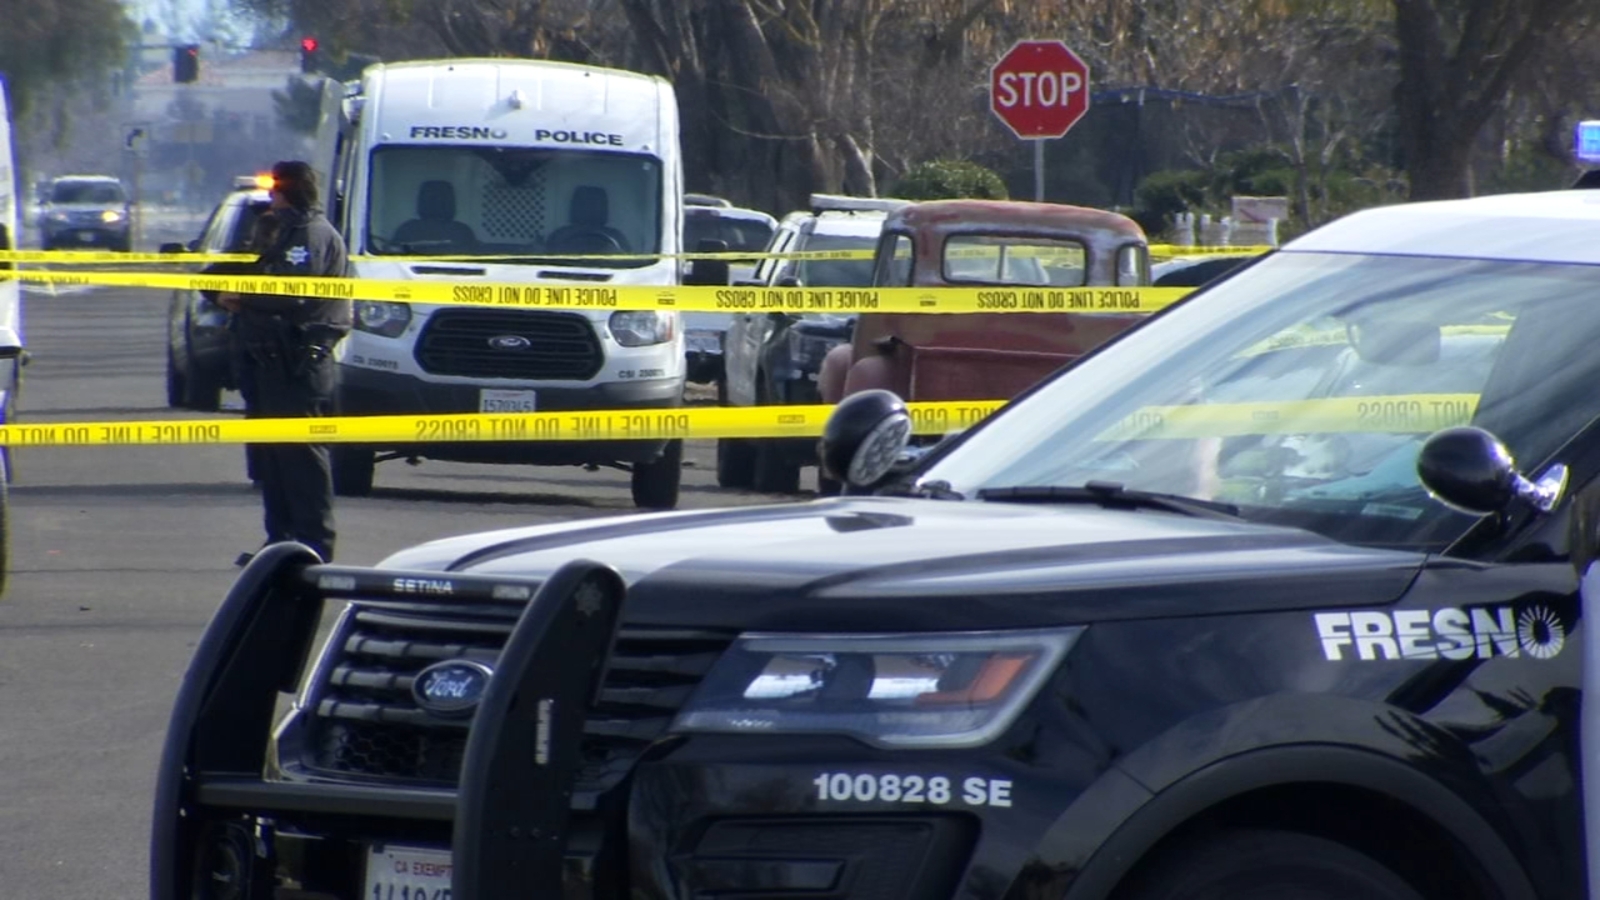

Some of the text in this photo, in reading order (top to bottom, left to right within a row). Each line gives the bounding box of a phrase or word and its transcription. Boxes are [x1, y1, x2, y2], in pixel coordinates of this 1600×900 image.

[999, 72, 1082, 108] STOP
[409, 126, 623, 146] FRESNO POLICE
[190, 279, 354, 298] POLICE LINE DO NOT CROSS
[453, 285, 617, 306] POLICE LINE DO NOT CROSS
[716, 291, 879, 308] POLICE LINE DO NOT CROSS
[977, 291, 1140, 309] POLICE LINE DO NOT CROSS
[393, 578, 454, 595] SETINA
[1314, 605, 1565, 661] FRESNO
[424, 672, 474, 699] Ford
[813, 773, 1013, 807] 100828 SE
